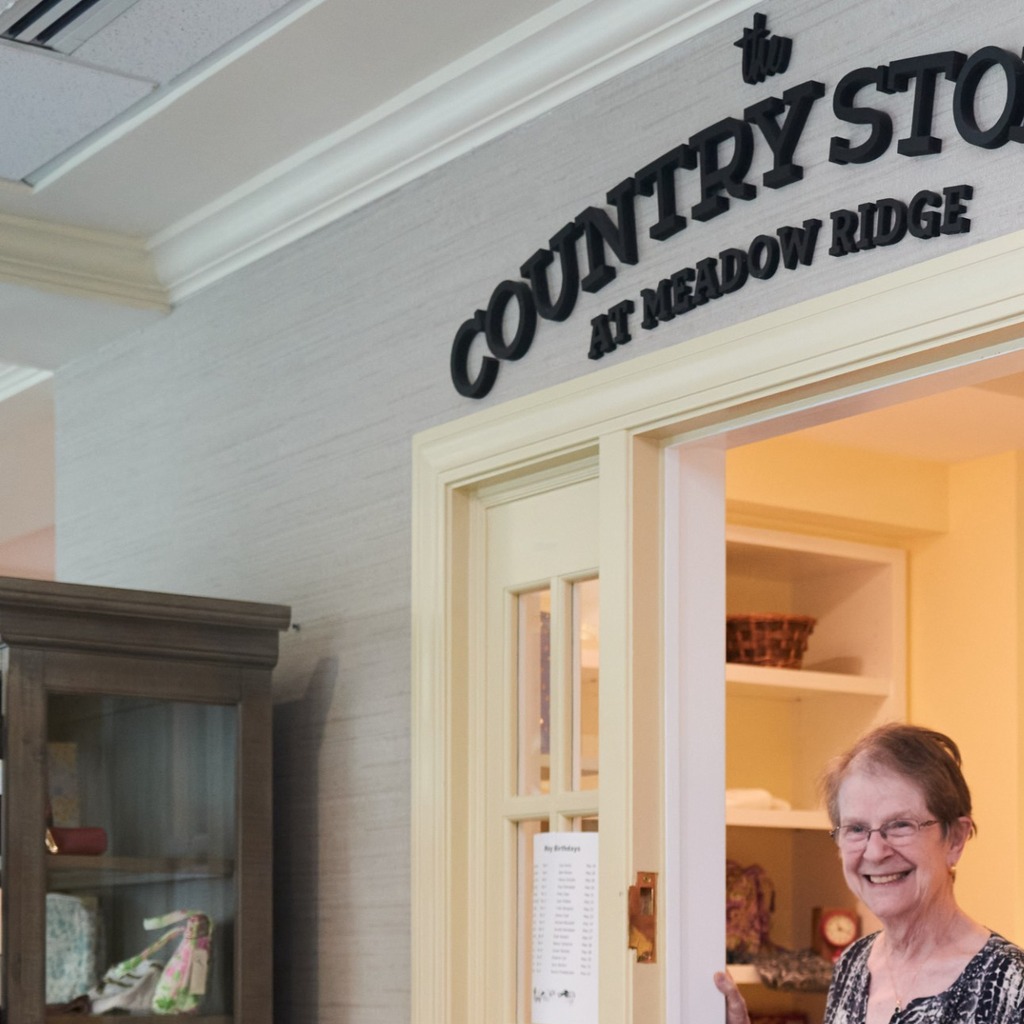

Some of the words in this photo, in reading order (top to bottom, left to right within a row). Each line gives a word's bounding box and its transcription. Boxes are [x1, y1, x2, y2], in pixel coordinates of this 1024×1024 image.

[734, 13, 792, 84] the
[450, 80, 826, 400] COUNTRY
[588, 300, 635, 360] AT
[641, 219, 822, 330] MEADOW
[828, 184, 973, 257] RIDGE
